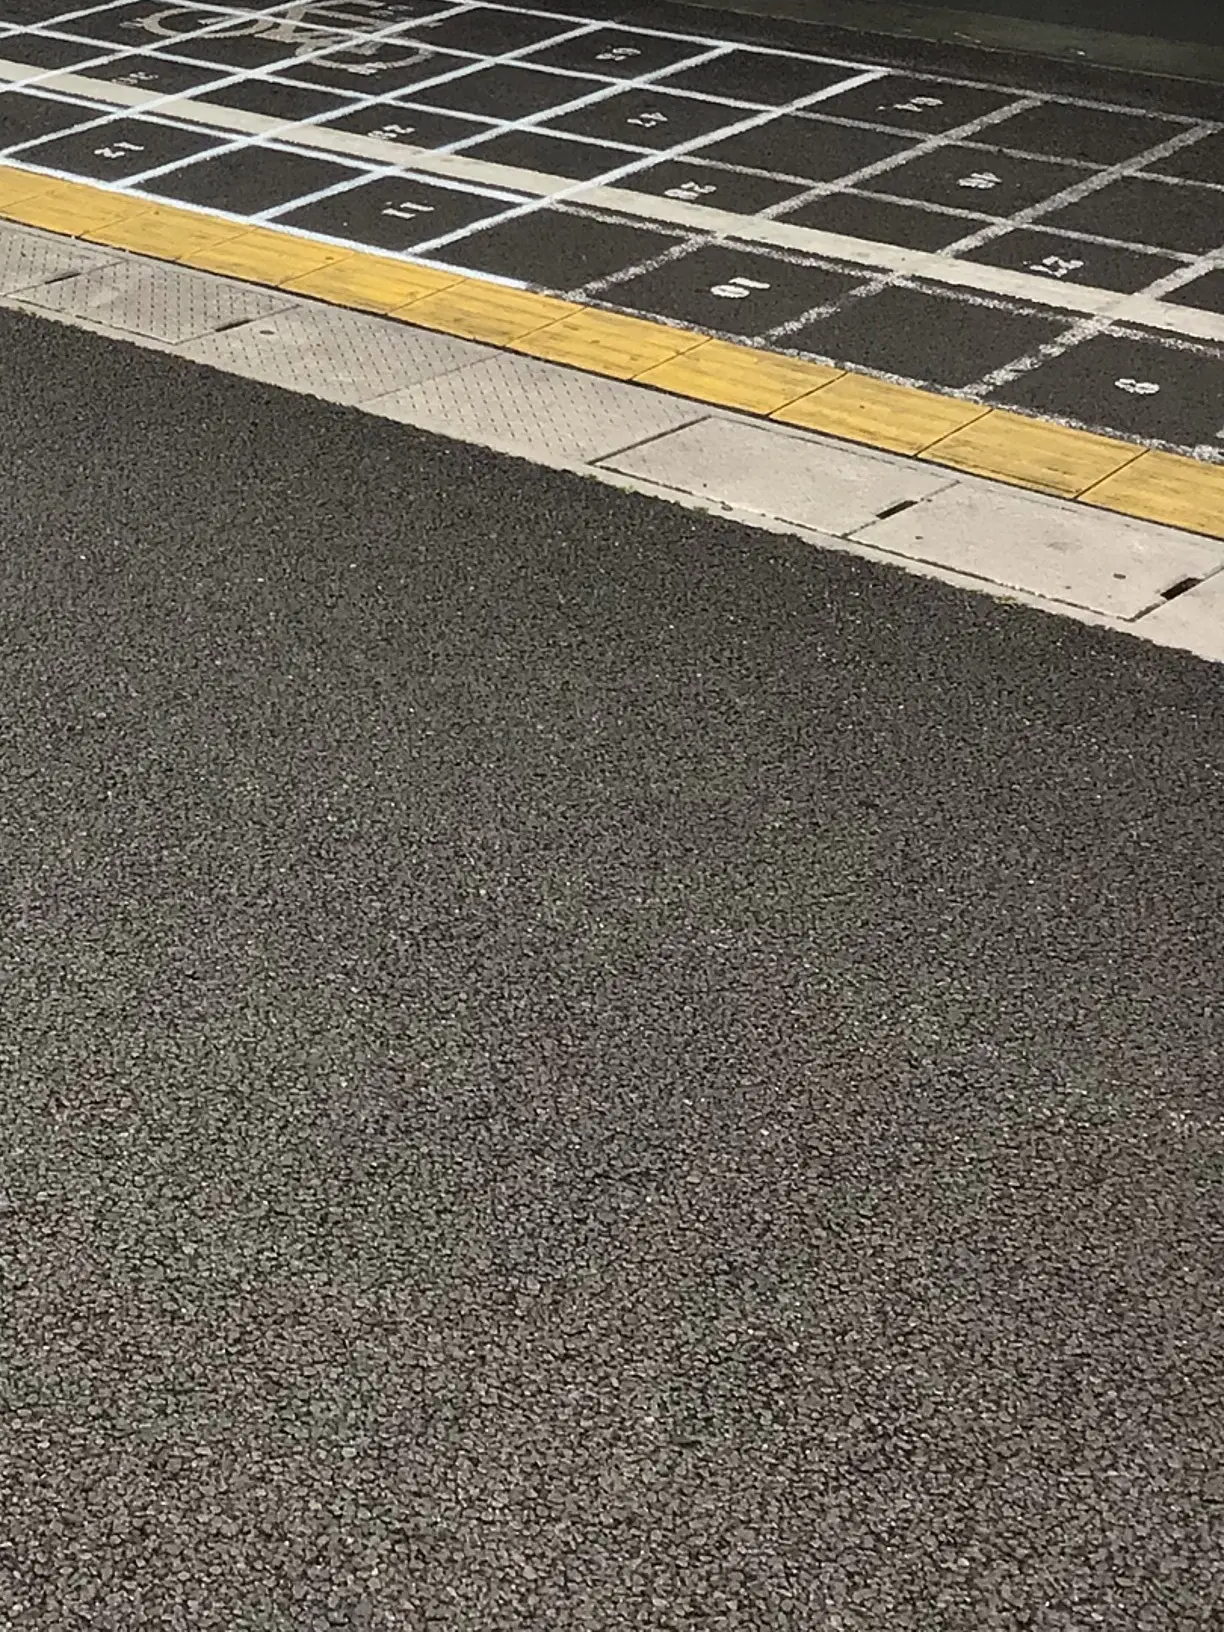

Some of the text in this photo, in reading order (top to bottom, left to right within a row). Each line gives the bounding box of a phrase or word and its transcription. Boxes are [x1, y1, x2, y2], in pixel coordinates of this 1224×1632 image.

[594, 46, 641, 61] 65
[891, 96, 943, 112] 64
[625, 111, 667, 128] 47
[92, 140, 144, 158] 12
[956, 171, 1000, 189] 46
[662, 180, 716, 200] 28
[380, 200, 434, 219] 11
[1027, 254, 1083, 278] 27
[708, 276, 769, 299] 10
